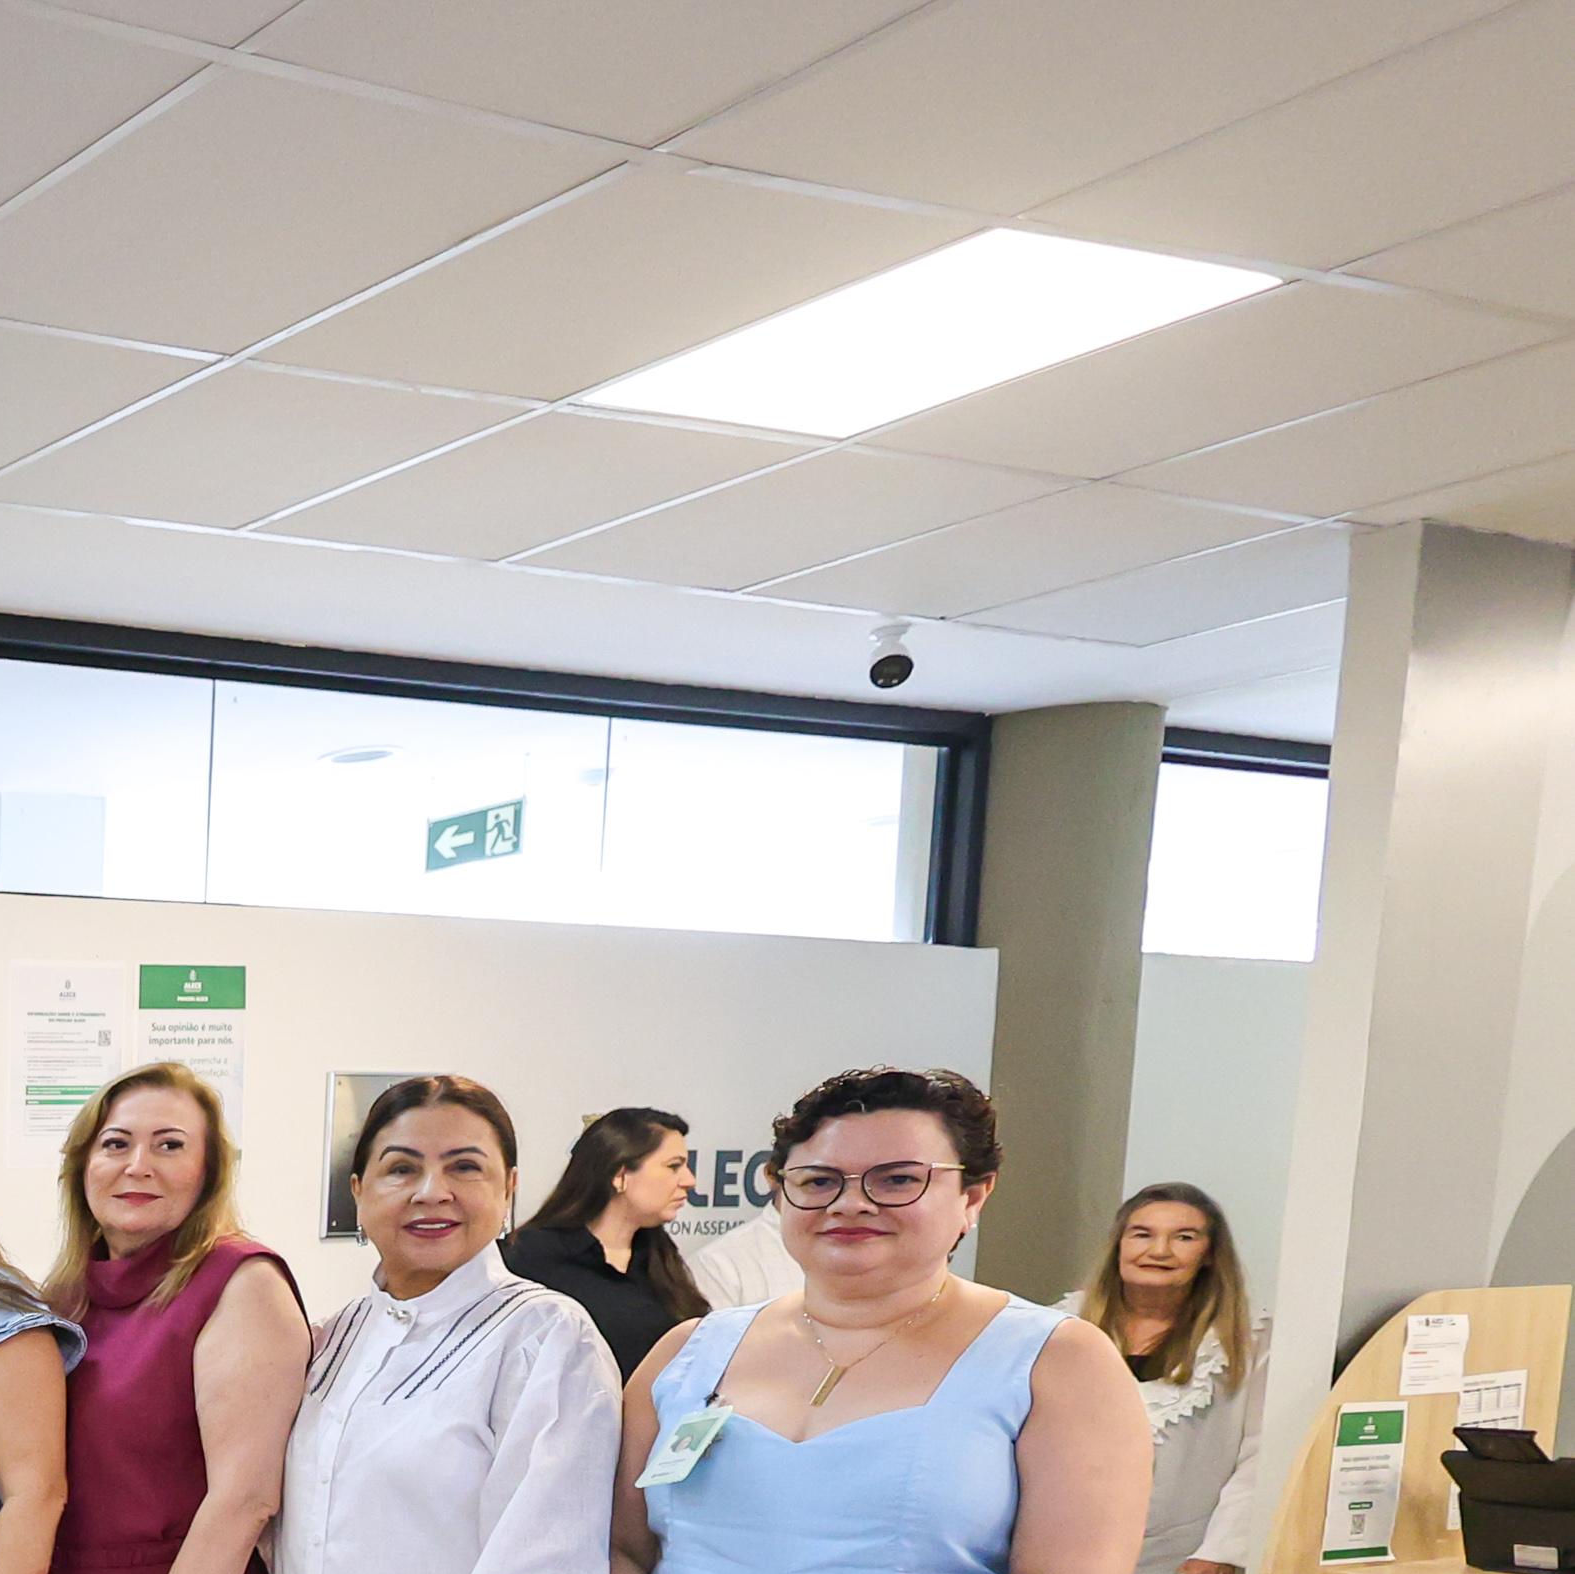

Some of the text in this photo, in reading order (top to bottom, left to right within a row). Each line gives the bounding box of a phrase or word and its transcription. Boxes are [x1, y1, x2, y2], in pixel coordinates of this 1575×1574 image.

[151, 1022, 166, 1032] Sua
[168, 1021, 199, 1033] opinião
[208, 1023, 233, 1032] muito
[148, 1036, 234, 1047] importante para nós.
